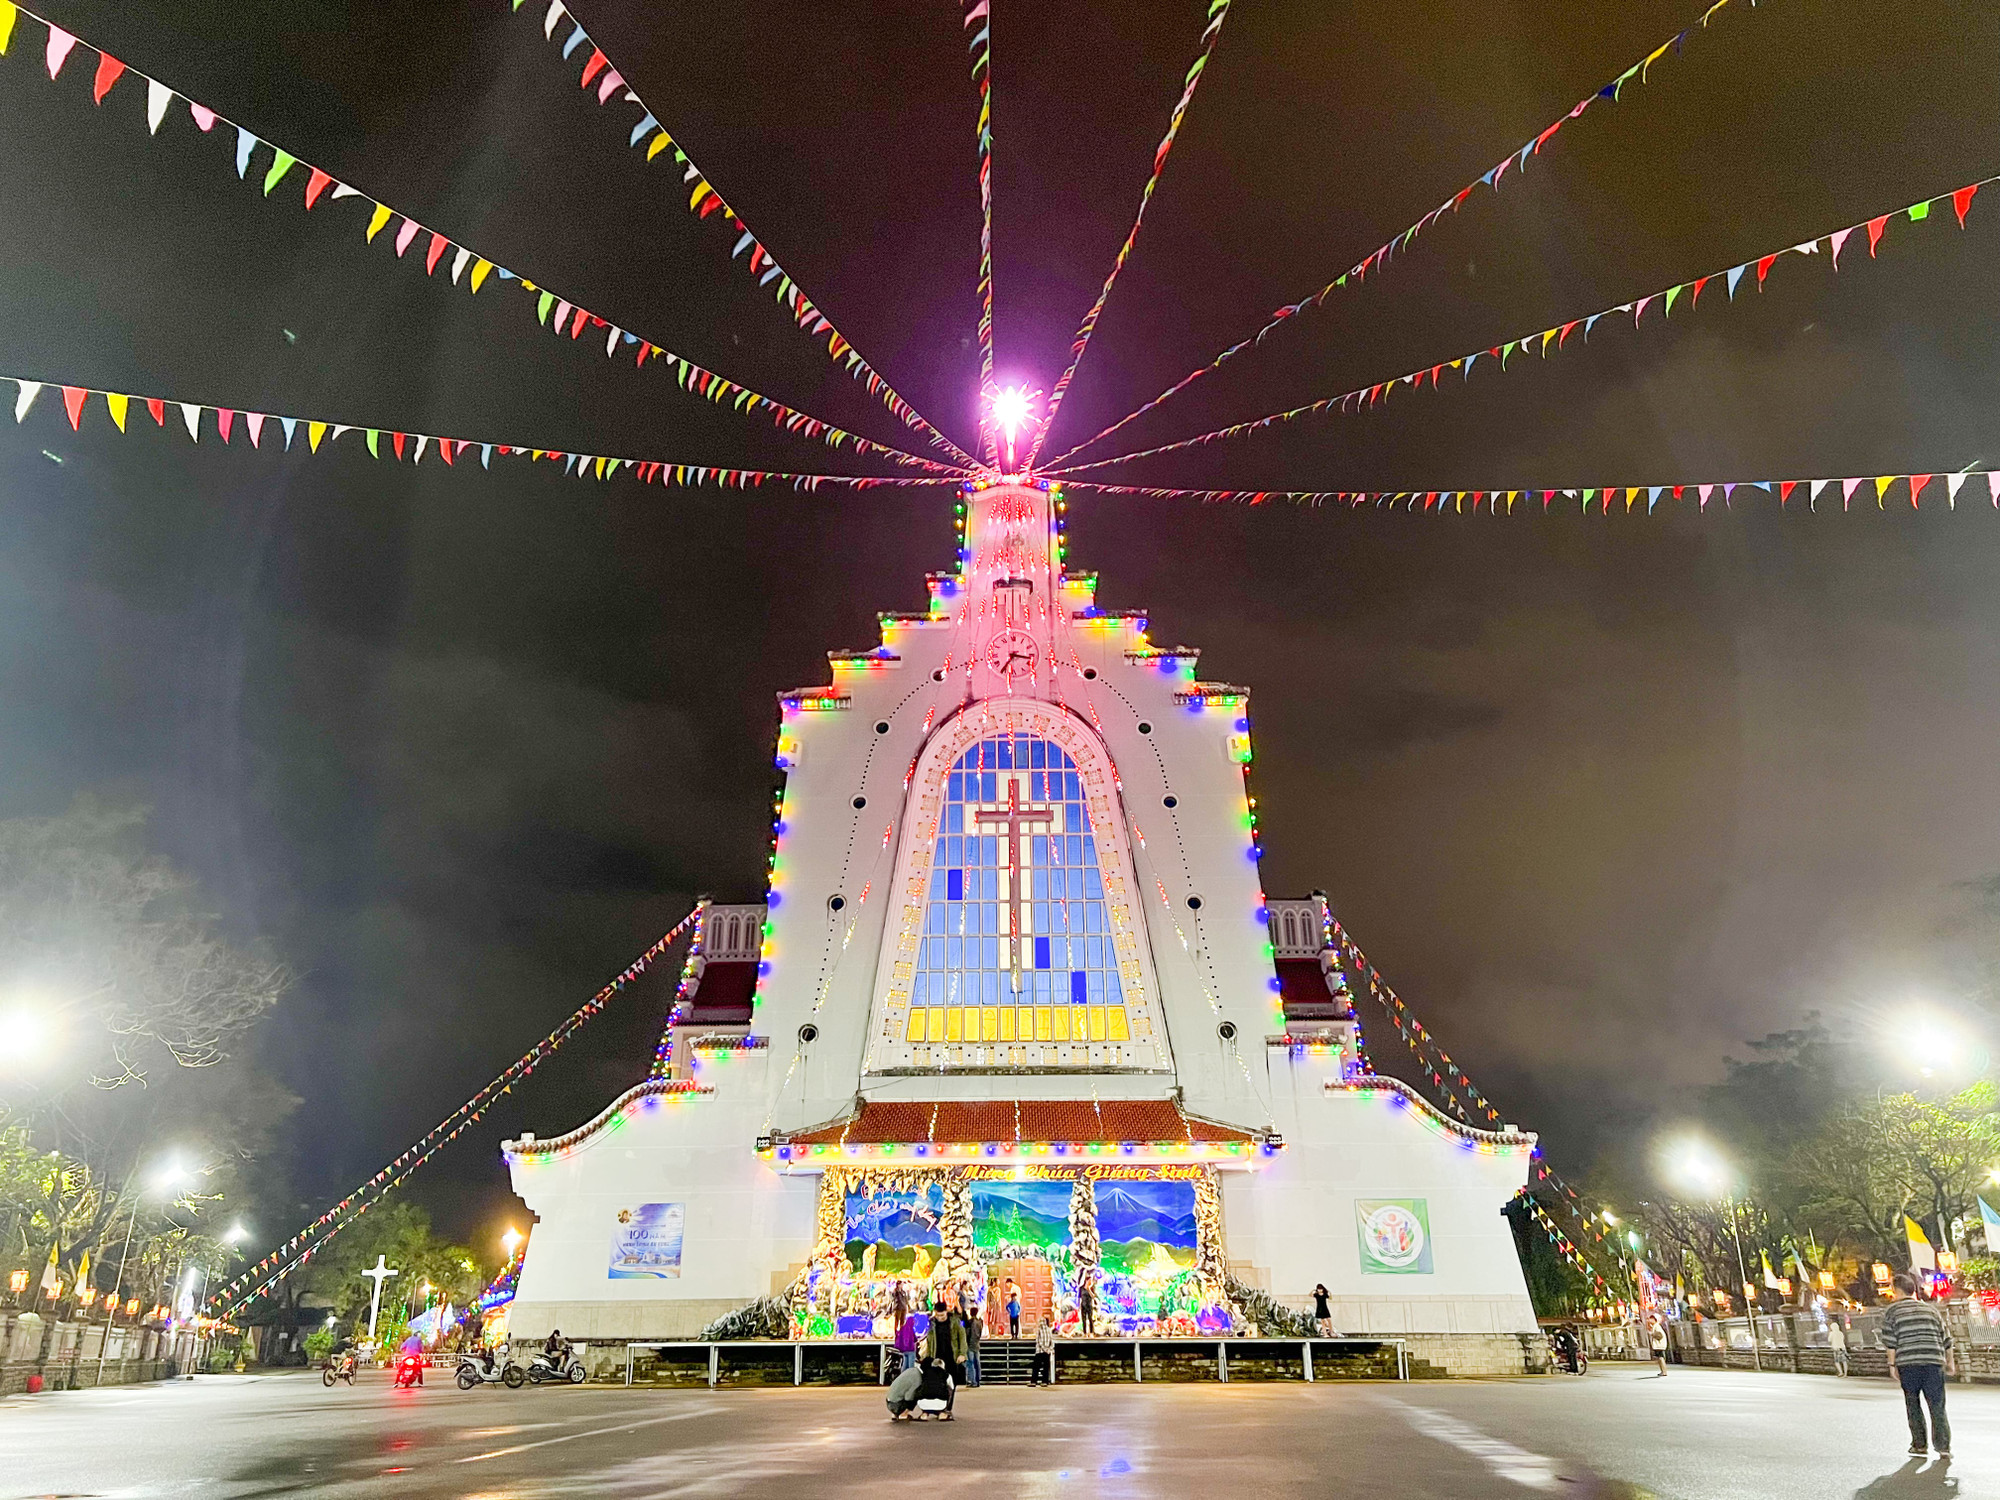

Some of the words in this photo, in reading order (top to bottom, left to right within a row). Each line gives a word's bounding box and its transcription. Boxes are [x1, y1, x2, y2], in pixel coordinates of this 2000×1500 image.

[1024, 1163, 1078, 1180] Chúa
[1083, 1163, 1150, 1182] Giáng
[1154, 1162, 1204, 1180] Sinh
[629, 1229, 649, 1240] 100
